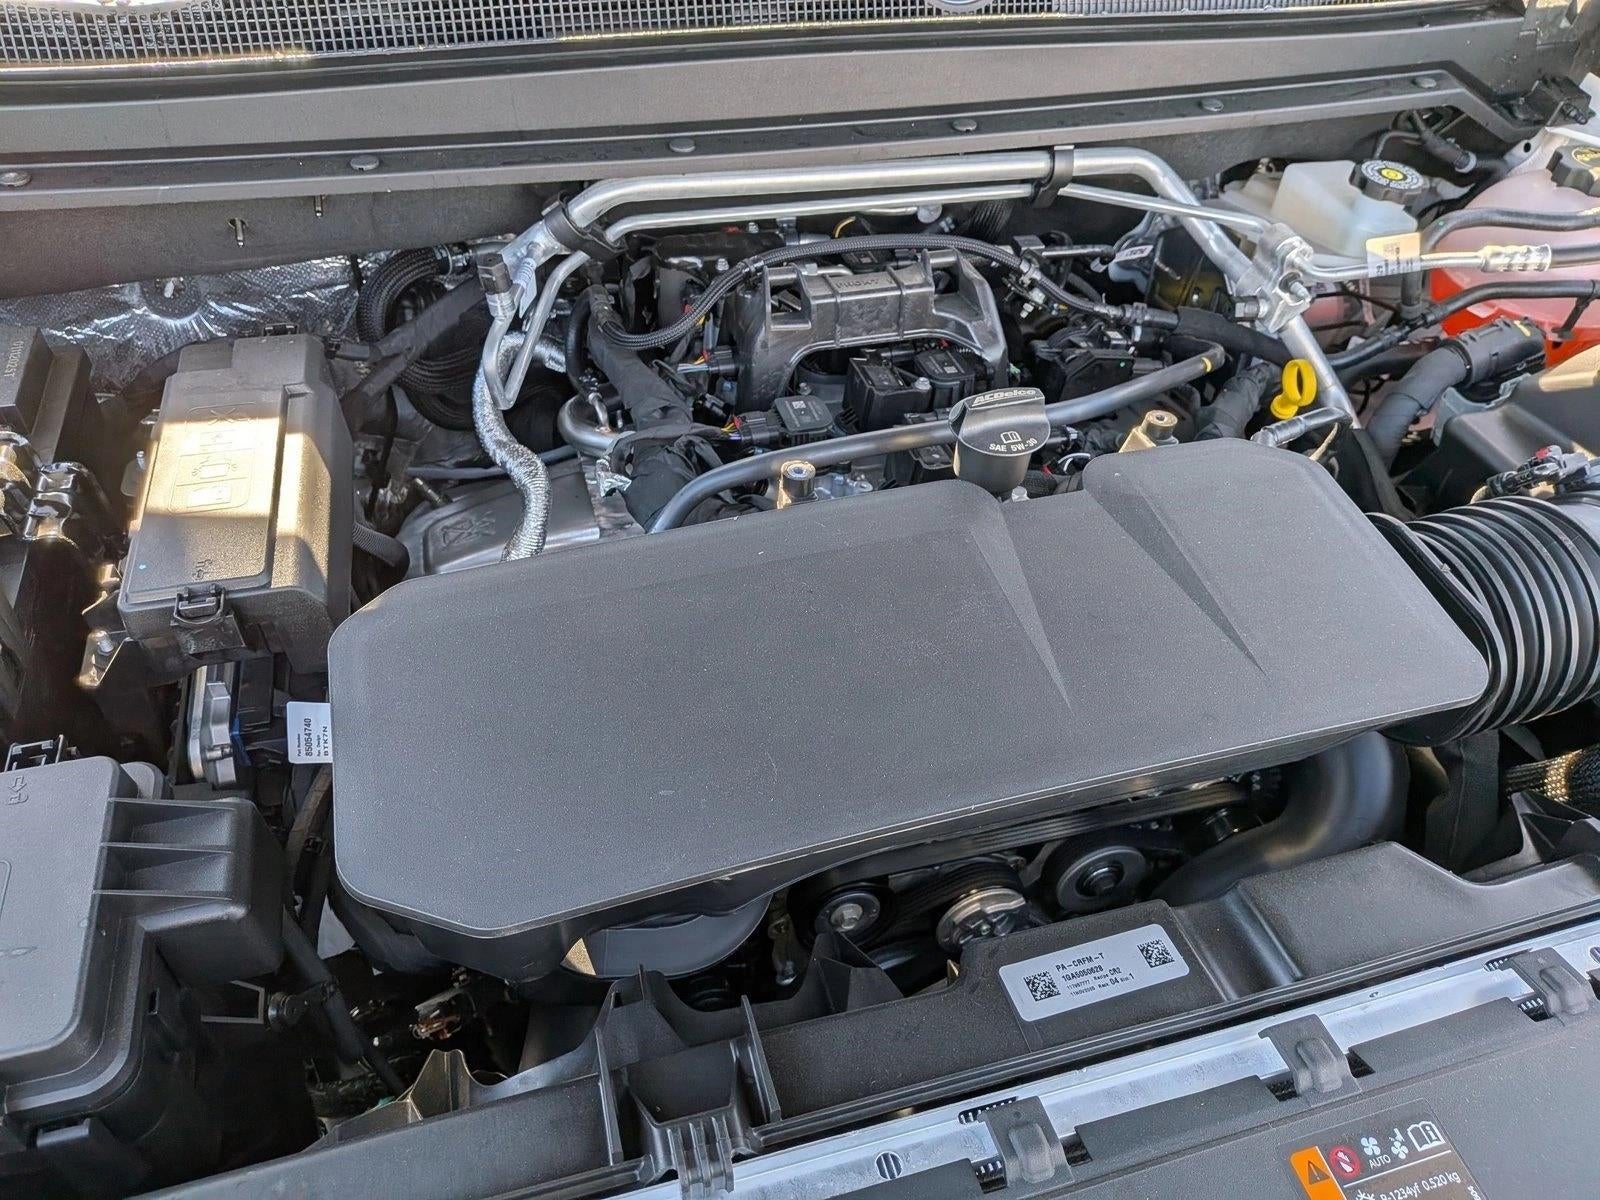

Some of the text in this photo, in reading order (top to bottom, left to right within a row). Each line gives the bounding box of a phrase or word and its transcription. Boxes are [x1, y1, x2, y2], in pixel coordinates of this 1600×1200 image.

[972, 389, 1036, 406] ACDelco
[989, 437, 1038, 452] SAE 5W-30
[304, 718, 313, 757] 85054740
[1055, 952, 1105, 972] PA-CRFM-T
[1109, 976, 1120, 986] 04
[1368, 1154, 1391, 1169] AUTO
[1421, 1174, 1447, 1191] 0.520
[1445, 1171, 1461, 1184] kg
